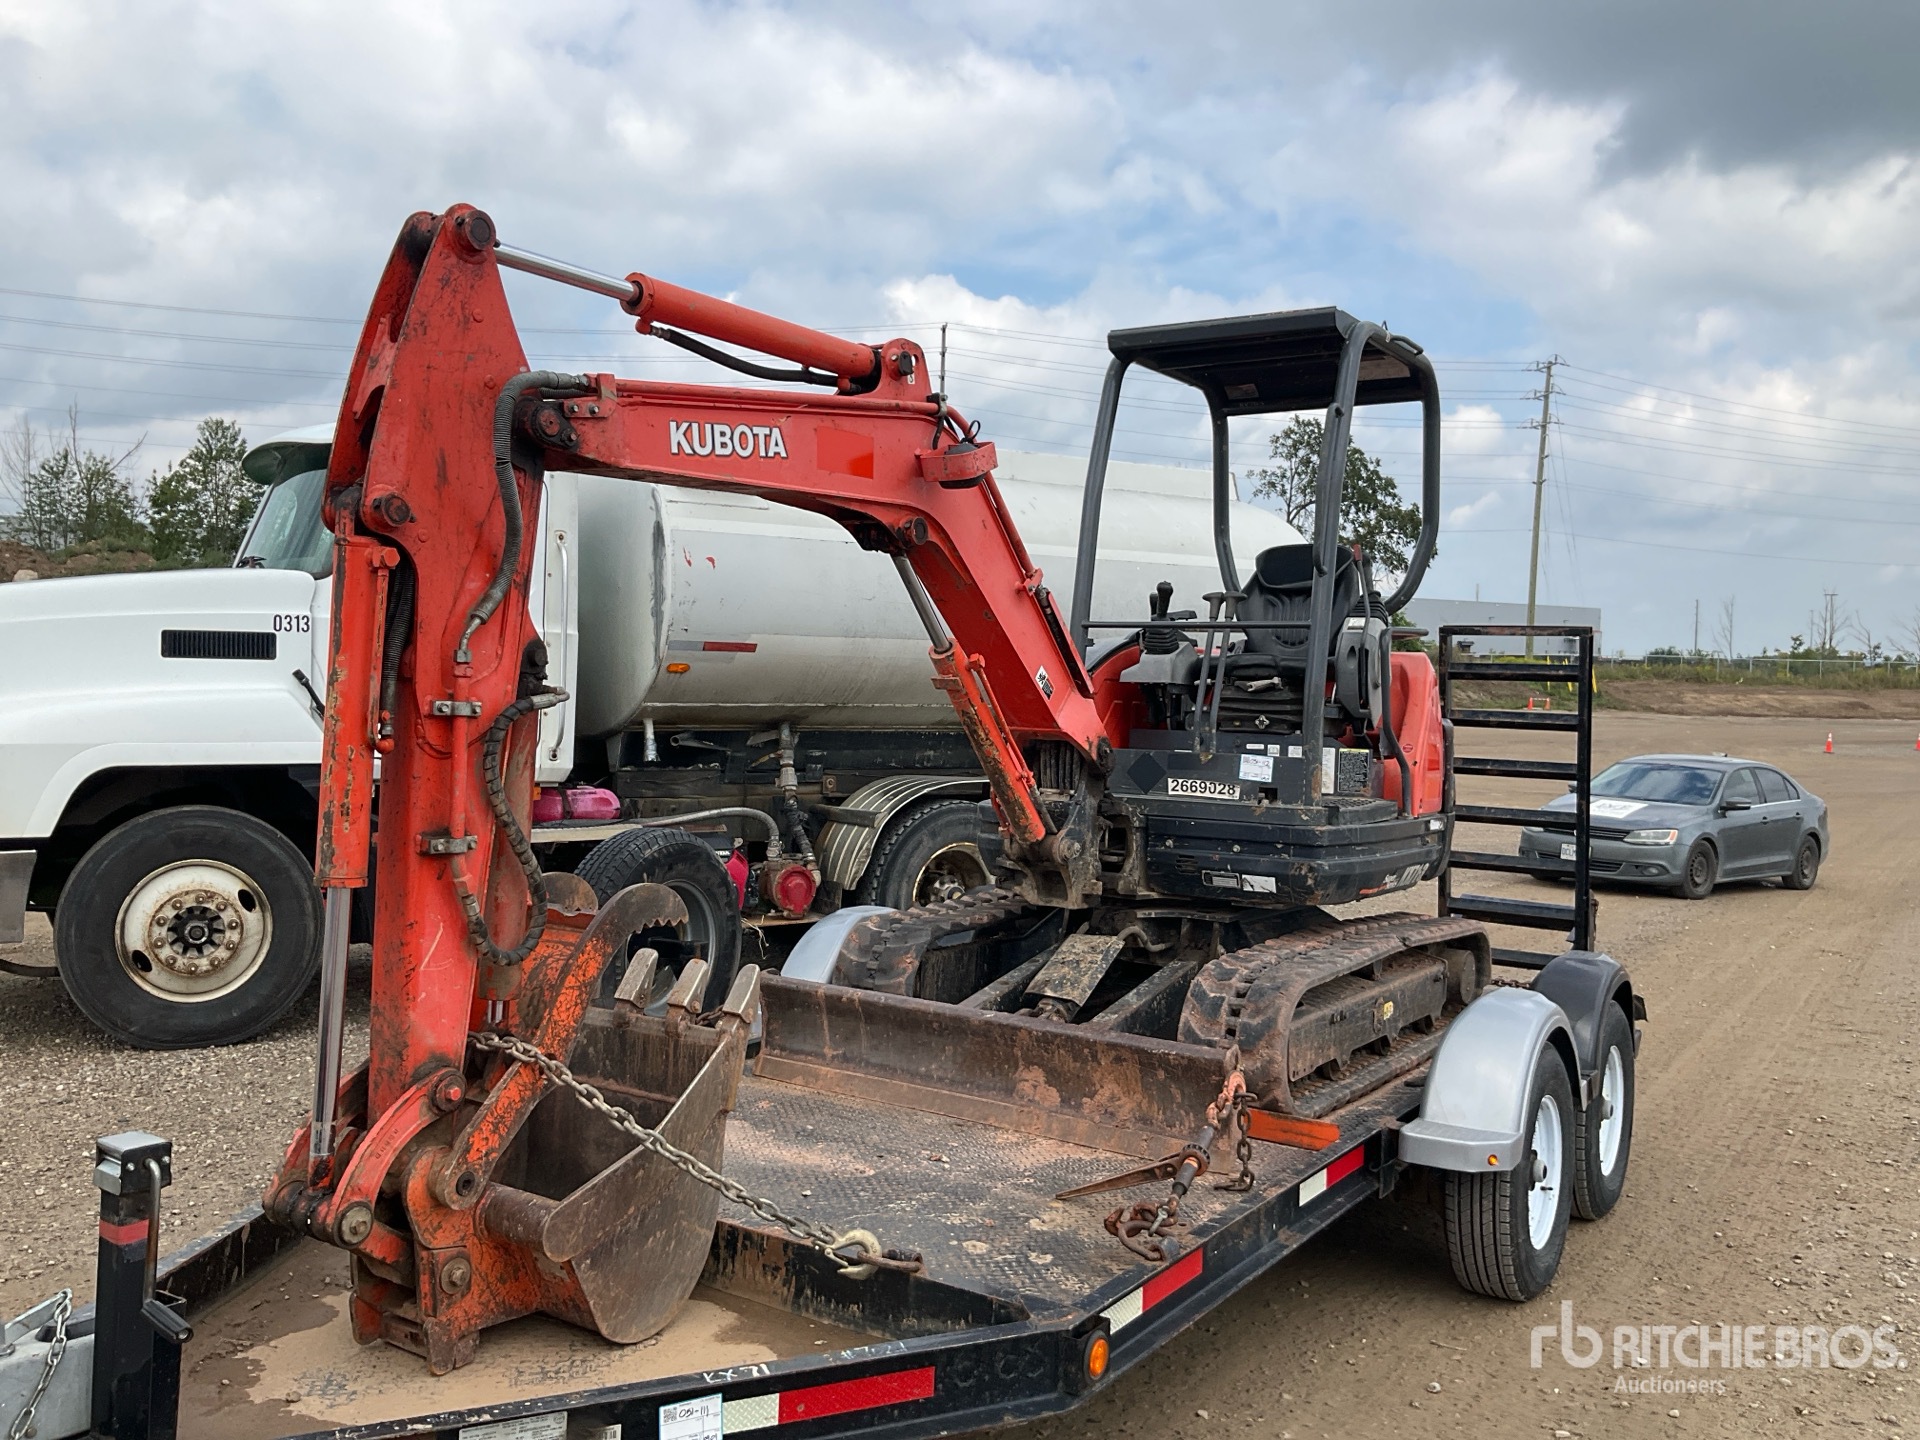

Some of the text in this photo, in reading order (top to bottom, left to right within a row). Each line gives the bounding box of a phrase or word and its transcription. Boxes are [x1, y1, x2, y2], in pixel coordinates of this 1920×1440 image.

[669, 420, 787, 458] KUBOTA
[273, 614, 310, 632] 0313
[1170, 779, 1236, 796] 2669028
